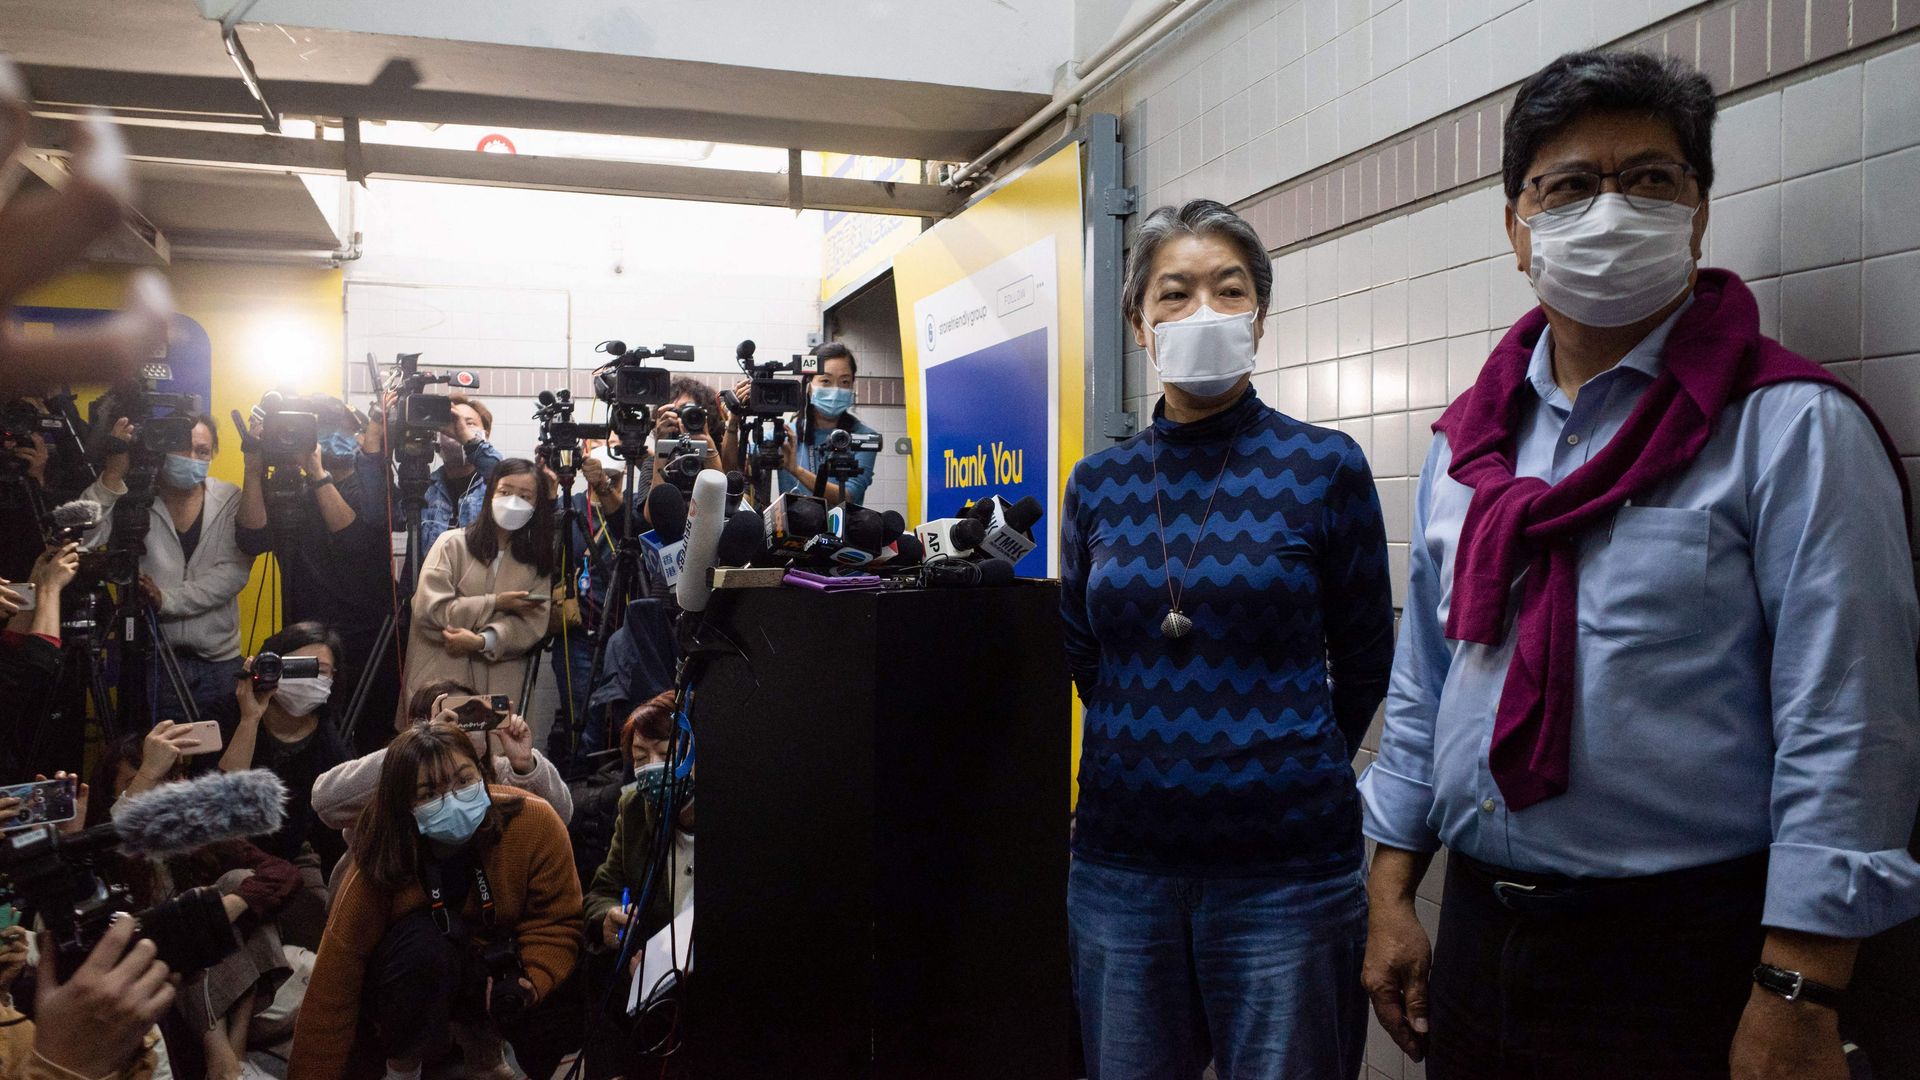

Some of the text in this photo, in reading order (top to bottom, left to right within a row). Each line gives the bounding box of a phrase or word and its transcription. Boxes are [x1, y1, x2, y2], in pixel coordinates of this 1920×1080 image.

[1004, 288, 1026, 305] FOLLOW
[803, 359, 817, 368] AP
[944, 441, 1023, 488] Thank You
[679, 519, 692, 573] REUTERS
[928, 532, 940, 553] AP
[473, 867, 490, 901] SONY
